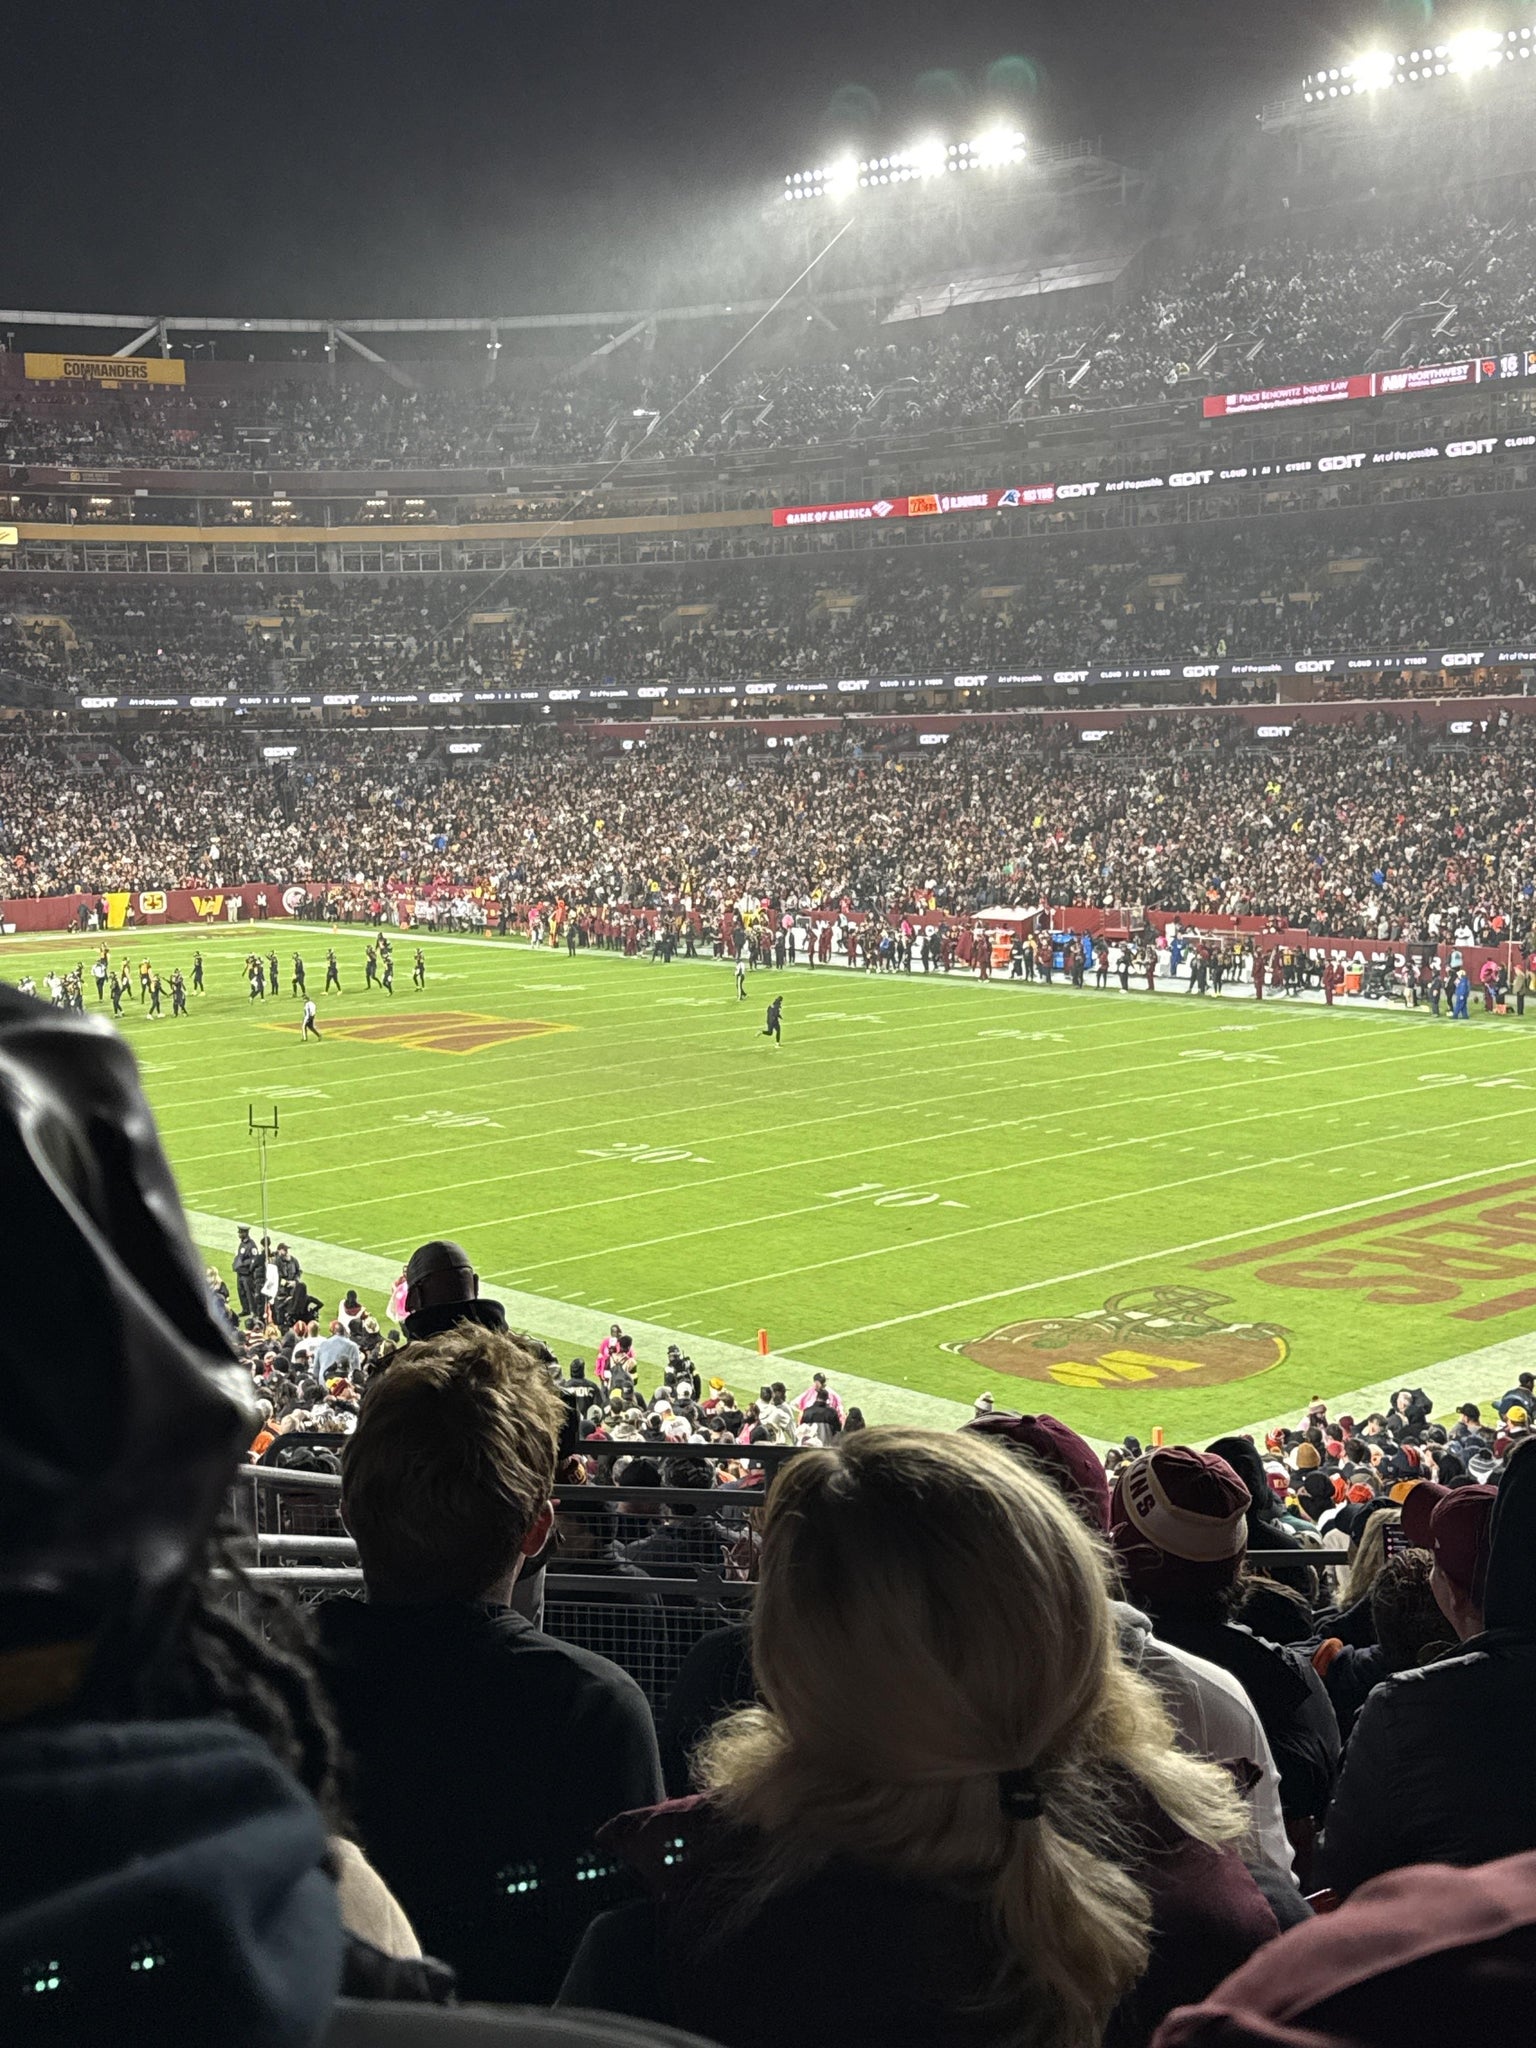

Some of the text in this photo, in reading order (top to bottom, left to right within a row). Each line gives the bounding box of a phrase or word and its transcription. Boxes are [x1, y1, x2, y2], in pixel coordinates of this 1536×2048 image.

[64, 362, 147, 379] COMMANDERS
[1408, 365, 1469, 381] NORTHWEST
[1262, 388, 1301, 400] BENOWITZ
[1303, 383, 1329, 395] INJURY
[1331, 381, 1348, 391] LAW
[1445, 438, 1498, 457] GDIT
[1505, 436, 1536, 447] CLOUD
[1318, 453, 1366, 472] GDIT
[1395, 452, 1407, 460] the
[1407, 448, 1439, 461] possible.
[1169, 470, 1214, 487] GDIT
[1220, 469, 1247, 479] CLOUD
[1056, 482, 1100, 499] GDIT
[787, 508, 872, 524] BANK OF AMERICA
[1295, 660, 1335, 672] GDIT
[1441, 652, 1484, 666] GDIT
[1053, 671, 1089, 683] GDIT
[1183, 665, 1220, 677] GDIT
[954, 675, 988, 686] GDIT
[577, 1142, 694, 1165] 20
[815, 1181, 941, 1208] 10
